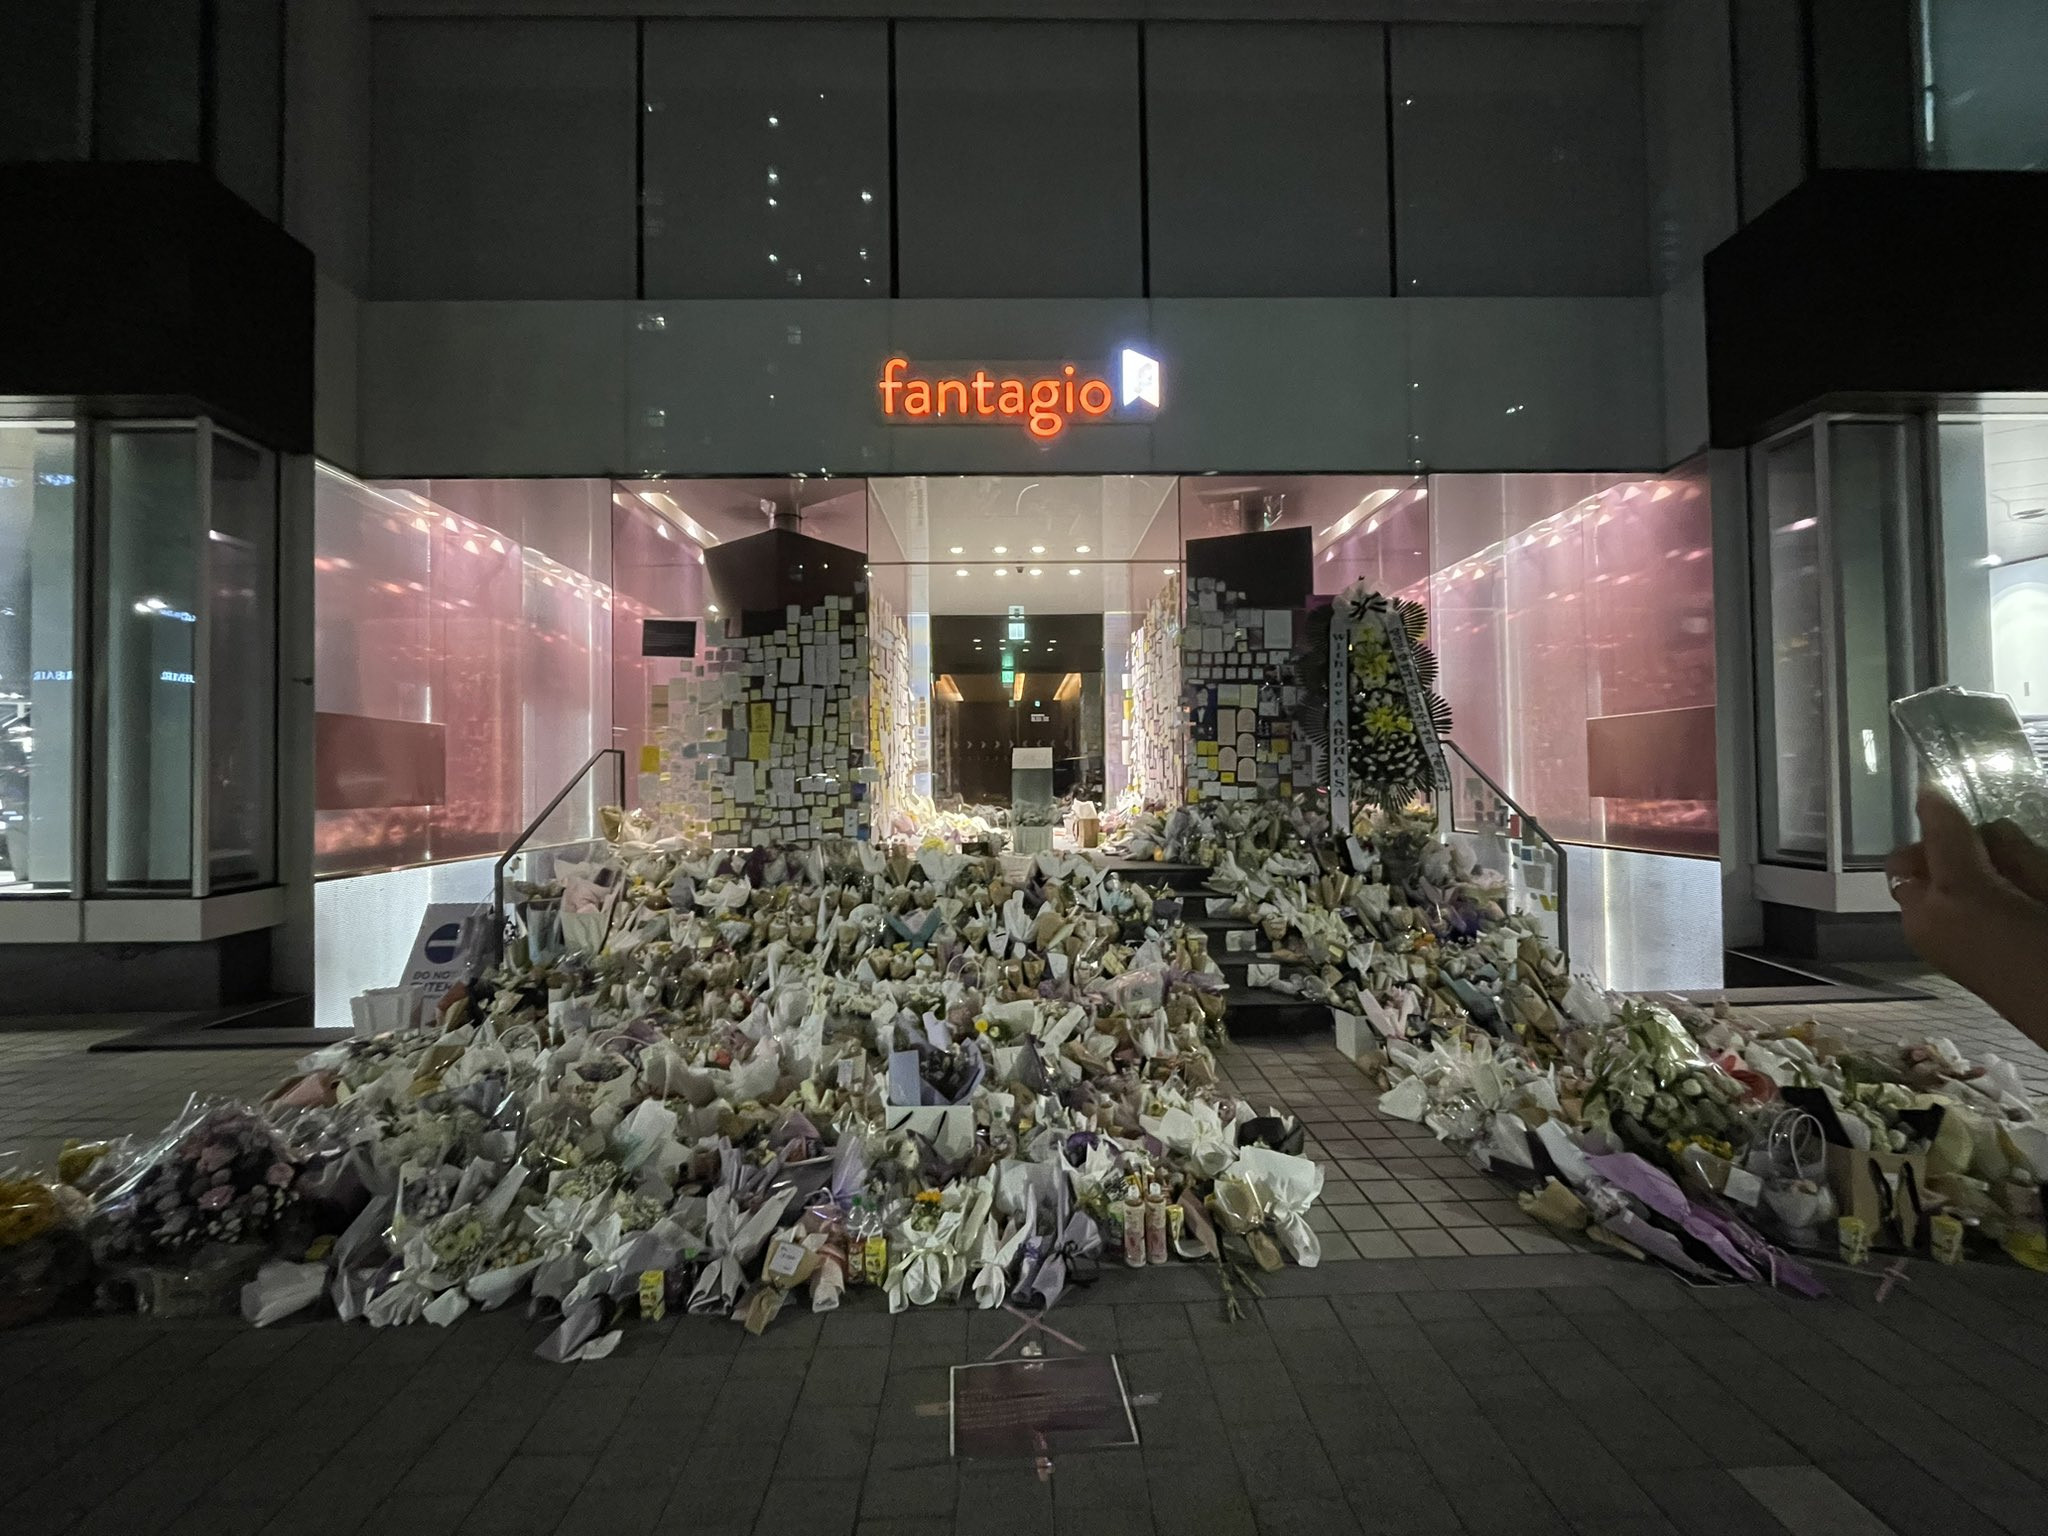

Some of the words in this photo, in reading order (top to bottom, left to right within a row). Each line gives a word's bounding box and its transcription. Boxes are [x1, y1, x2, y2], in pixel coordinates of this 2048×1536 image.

[878, 357, 1112, 437] fantagio
[1333, 718, 1346, 765] AROHA
[1334, 769, 1346, 797] USA
[413, 971, 430, 980] DO
